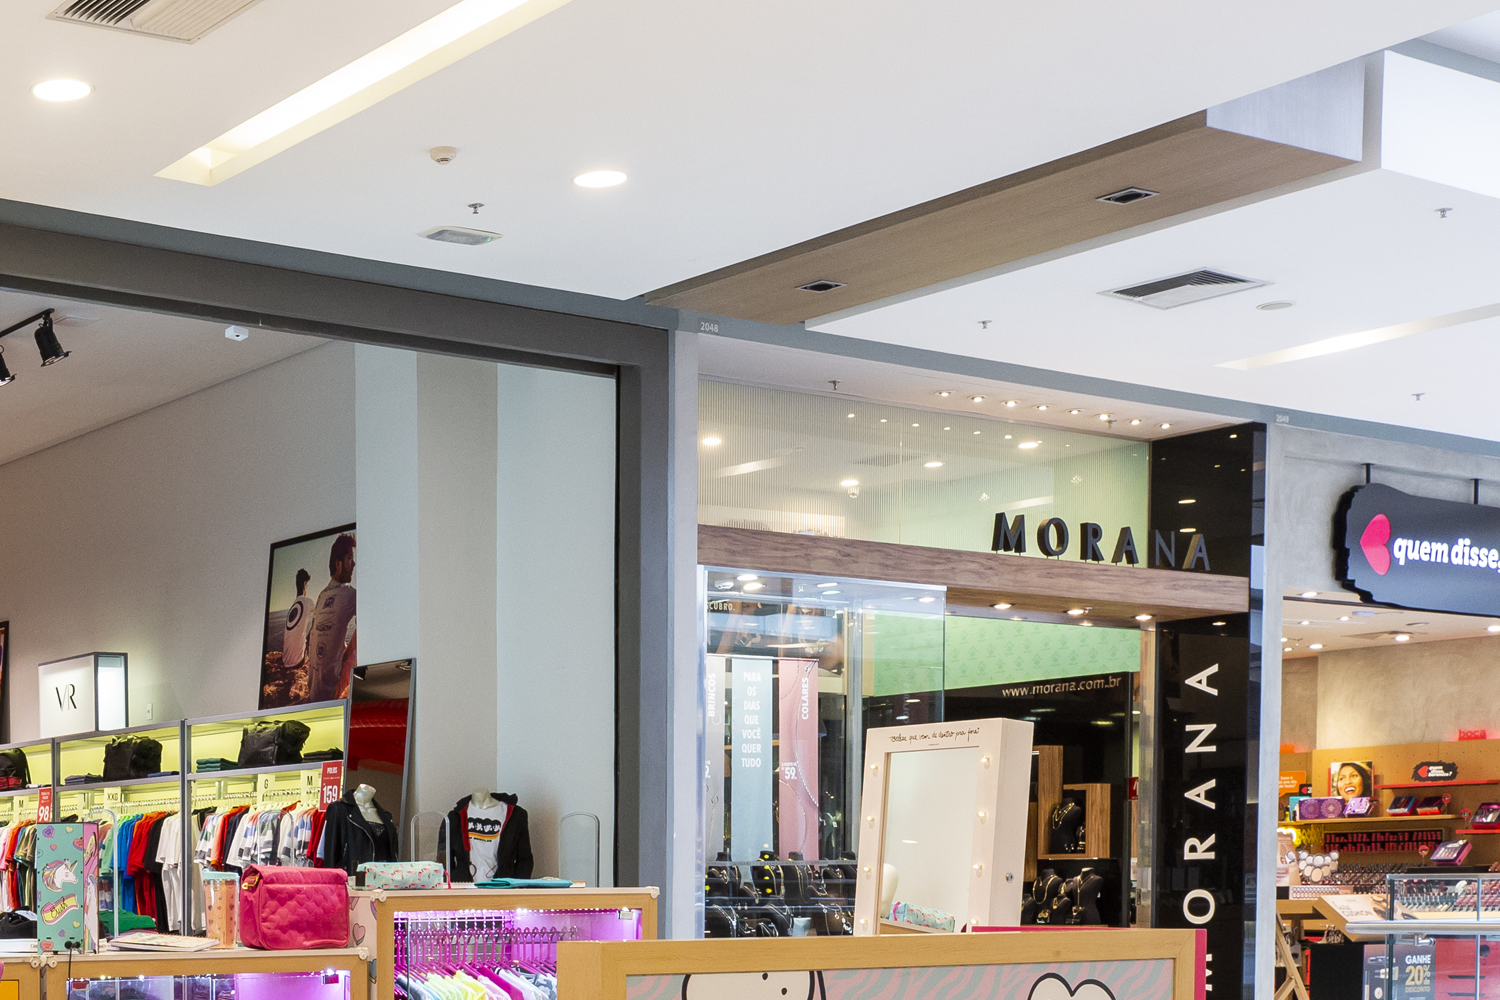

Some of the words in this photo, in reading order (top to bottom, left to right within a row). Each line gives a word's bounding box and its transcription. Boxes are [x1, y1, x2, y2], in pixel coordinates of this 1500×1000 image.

[700, 322, 719, 333] 2048
[991, 511, 1212, 572] MORANA
[1393, 537, 1449, 566] quem
[708, 601, 736, 612] CUBRO.
[743, 671, 762, 682] PARA
[746, 686, 757, 697] OS
[1001, 676, 1122, 698] www.morana.com.br
[55, 683, 77, 711] VR
[707, 672, 717, 718] BRINCOS
[801, 676, 810, 721] COLARES
[743, 700, 760, 711] DIAS
[744, 714, 760, 725] QUE
[741, 726, 762, 739] VOCÊ
[741, 743, 762, 754] QUER
[740, 757, 762, 768] TUDO
[263, 779, 269, 789] G
[306, 775, 313, 786] M
[322, 785, 338, 804] 159
[38, 805, 50, 822] 98
[1182, 662, 1220, 993] ORANA
[1404, 954, 1432, 965] GANHE
